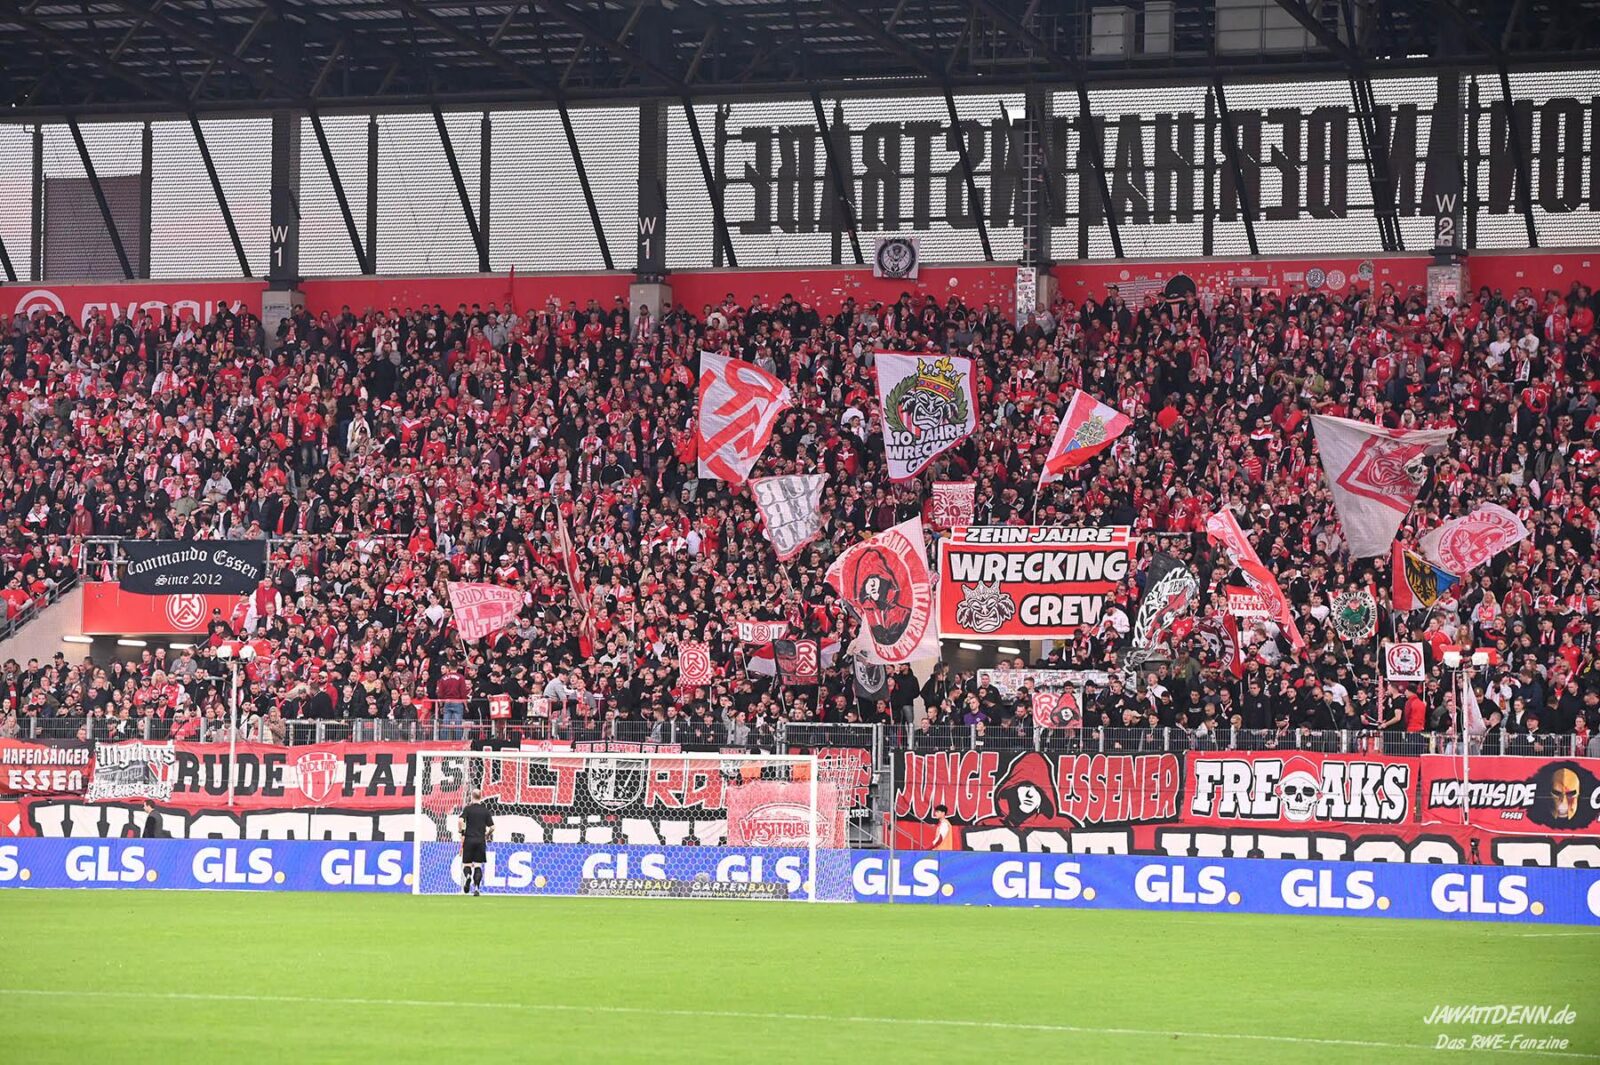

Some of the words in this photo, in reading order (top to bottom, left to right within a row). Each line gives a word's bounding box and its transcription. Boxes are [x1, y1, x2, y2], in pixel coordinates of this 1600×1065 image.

[1436, 194, 1456, 213] W
[270, 226, 289, 243] W
[638, 216, 657, 235] W
[1438, 216, 1454, 240] 2
[274, 247, 283, 267] 1
[641, 238, 650, 259] 1
[892, 431, 913, 446] 10
[916, 423, 966, 445] JAHRE
[966, 527, 1030, 543] ZEHN
[1031, 527, 1113, 543] JAHRE
[127, 546, 208, 576] Commando
[213, 549, 258, 579] Essen
[950, 551, 1128, 583] WRECKING
[155, 574, 190, 586] Since
[192, 573, 223, 586] 2012
[3, 745, 90, 765] HAFENSÄNGER
[8, 769, 83, 791] ESSEN
[175, 752, 287, 797] RUDE
[896, 751, 999, 821] JUNGE
[1056, 752, 1180, 823] ESSENER
[1193, 760, 1409, 824] FREAKS
[1430, 780, 1537, 808] NORTHSIDE
[1500, 811, 1523, 820] ESSEN
[65, 845, 158, 882] GLS.
[192, 847, 286, 885] GLS.
[589, 879, 672, 890] GARTENBAU
[692, 881, 776, 892] GARTENBAU
[992, 861, 1096, 900] GLS.
[1134, 864, 1241, 906] GLS.
[1281, 868, 1390, 911] GLS.
[1431, 872, 1544, 916] GLS.
